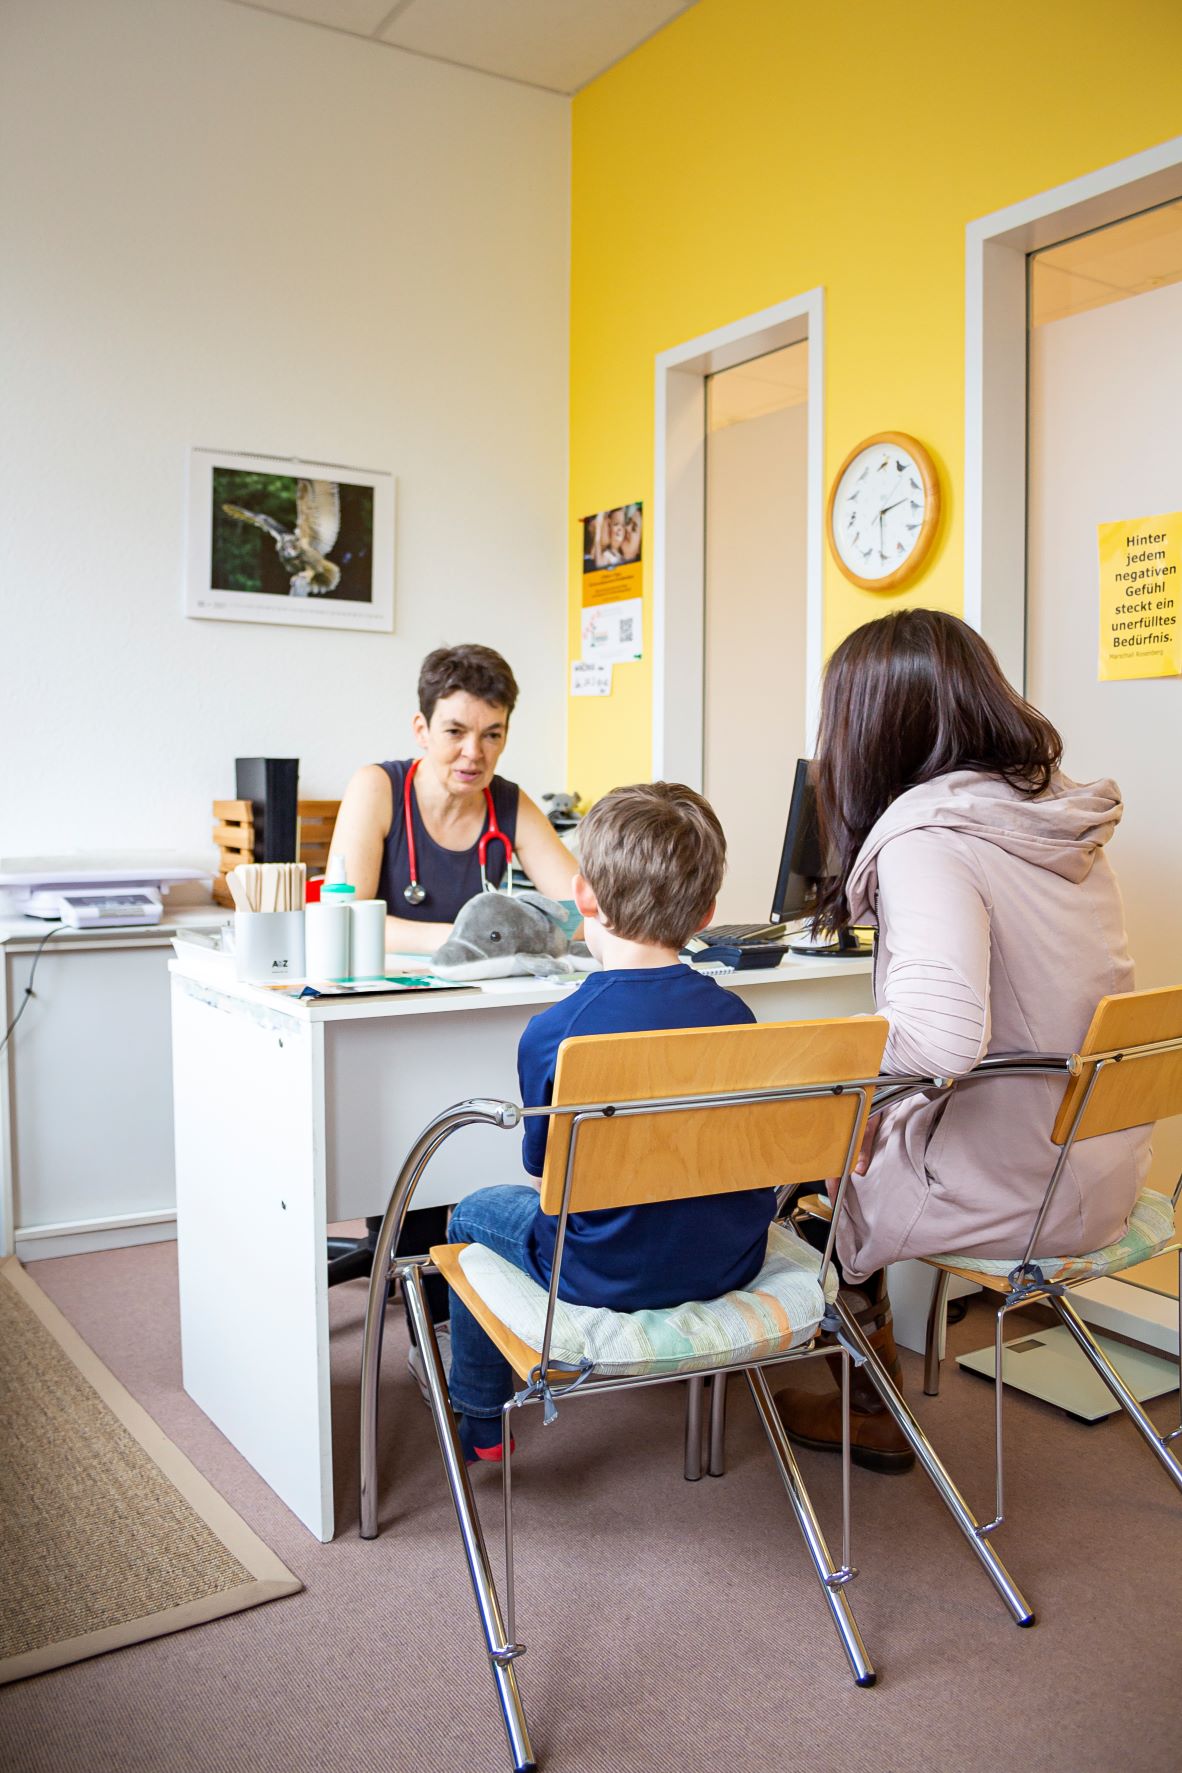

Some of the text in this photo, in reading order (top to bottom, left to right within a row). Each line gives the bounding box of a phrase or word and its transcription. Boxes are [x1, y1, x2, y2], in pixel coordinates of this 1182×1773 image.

[1126, 533, 1167, 547] Hinter
[1126, 550, 1166, 567] jedem
[1115, 565, 1177, 582] negativen
[1125, 581, 1165, 597] Gefühl
[1115, 597, 1174, 615] steckt ein
[1111, 615, 1177, 632] unerfülltes
[1113, 631, 1173, 648] Bedürfnis.
